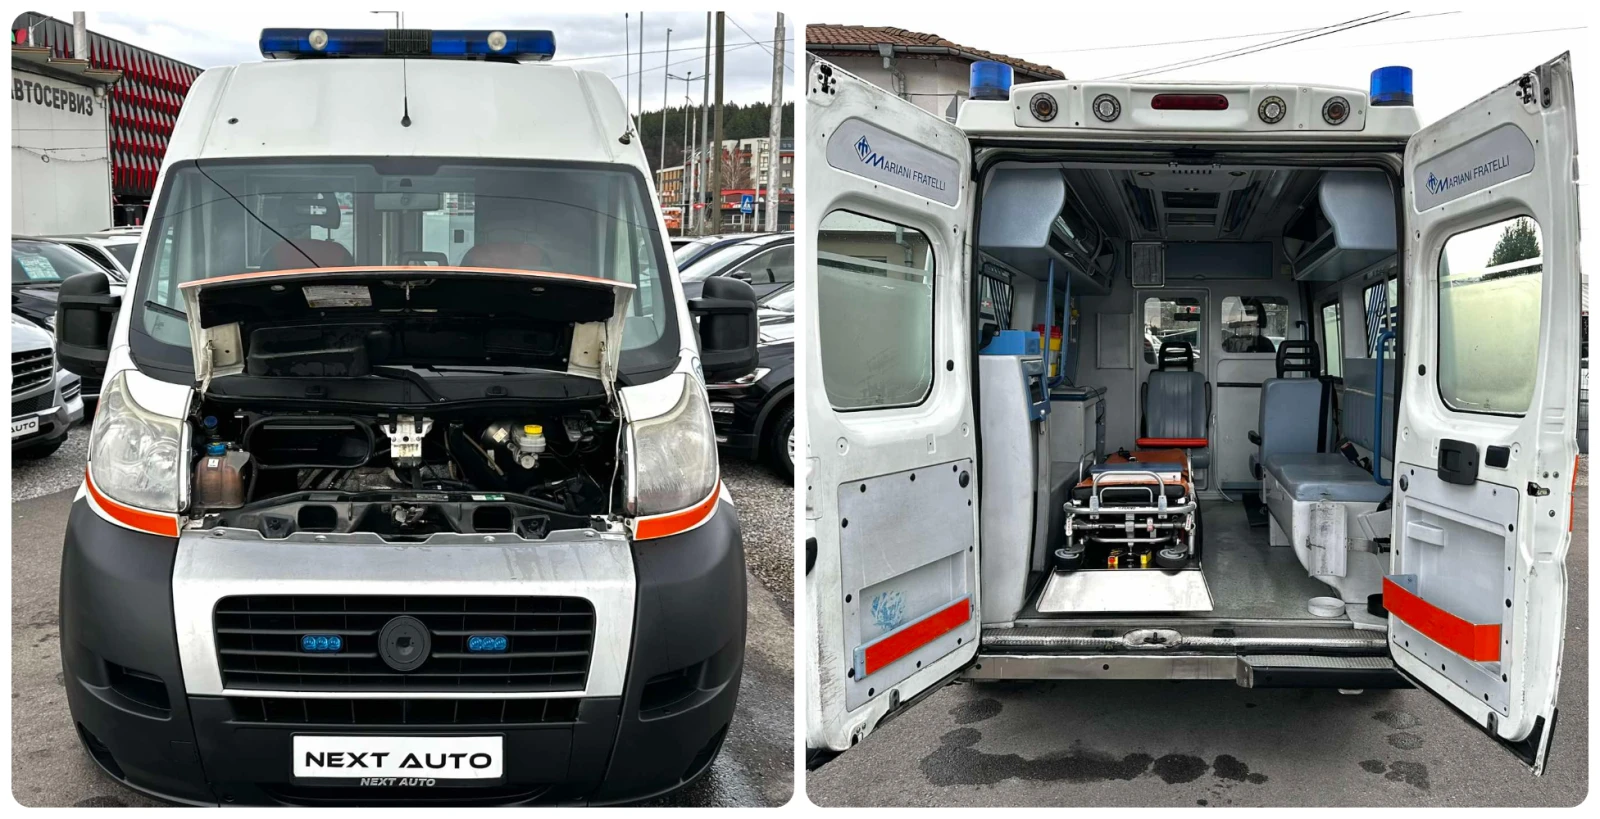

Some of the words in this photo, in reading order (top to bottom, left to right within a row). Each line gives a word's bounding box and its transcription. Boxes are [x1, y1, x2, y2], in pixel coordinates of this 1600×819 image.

[11, 78, 93, 116] ВТОСЕРВИЗ
[865, 153, 912, 179] MARIANI
[912, 171, 946, 191] FRATELLI
[1435, 170, 1473, 194] MARIANI
[1473, 155, 1510, 179] FRATELLI
[305, 751, 390, 768] NEXT
[398, 752, 492, 769] AUTO
[360, 777, 396, 787] NEXT
[399, 778, 436, 787] AUTO
